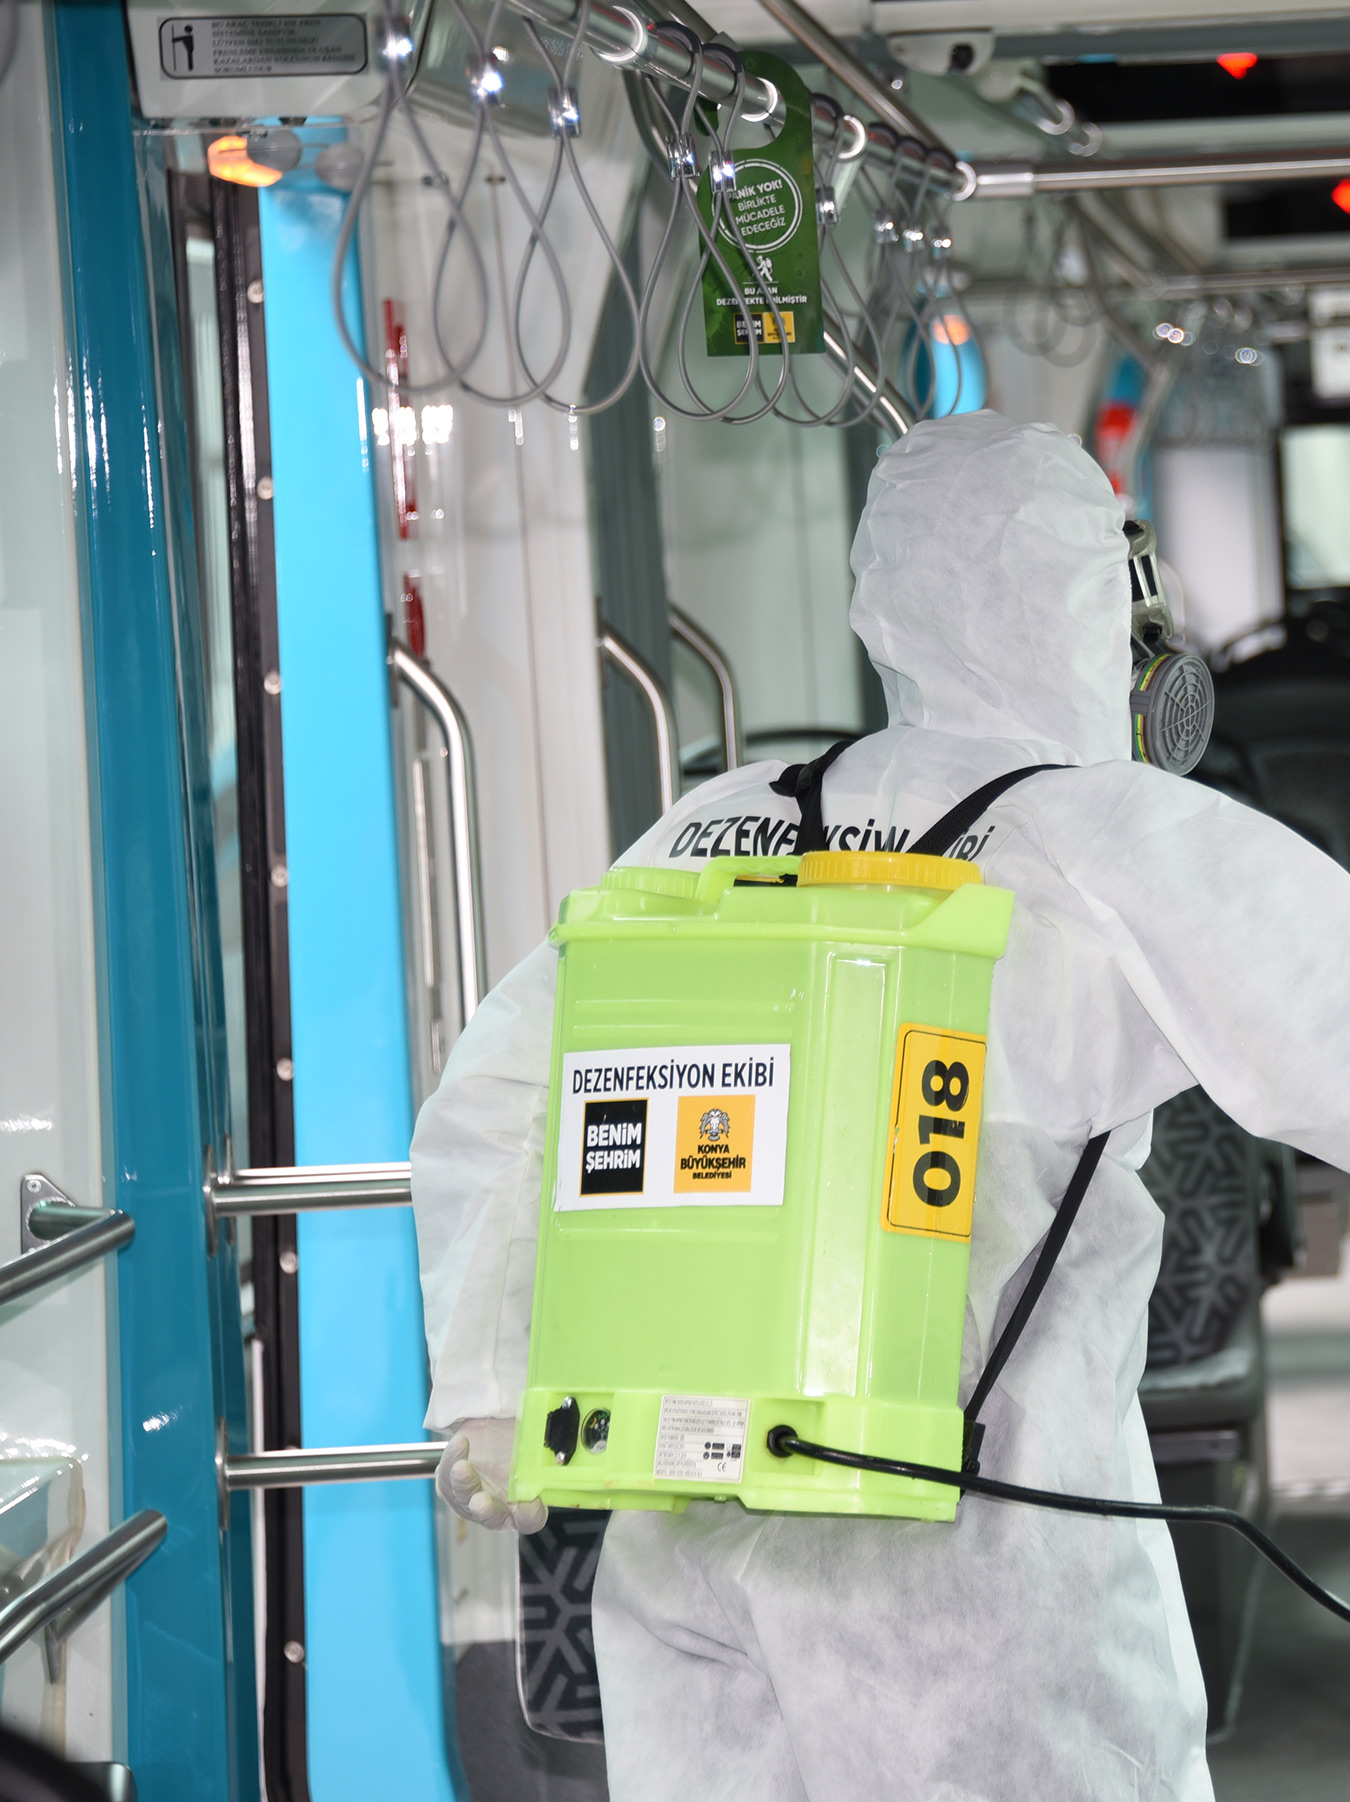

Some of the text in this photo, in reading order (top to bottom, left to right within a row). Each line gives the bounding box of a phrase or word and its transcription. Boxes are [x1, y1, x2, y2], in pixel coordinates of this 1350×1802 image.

[757, 179, 783, 193] YOK!
[738, 194, 776, 211] BİRLİKTE
[735, 205, 785, 225] MÜCADELE
[740, 217, 786, 236] EDECEĞİZ
[744, 287, 755, 295] BU
[572, 1056, 774, 1094] DEZENFEKSİYON EKİBİ
[913, 1059, 969, 1208] 018
[697, 1144, 730, 1154] KONYA
[680, 1154, 746, 1172] BÜYÜKŞEHİR
[692, 1171, 732, 1180] BELEDİYESİ
